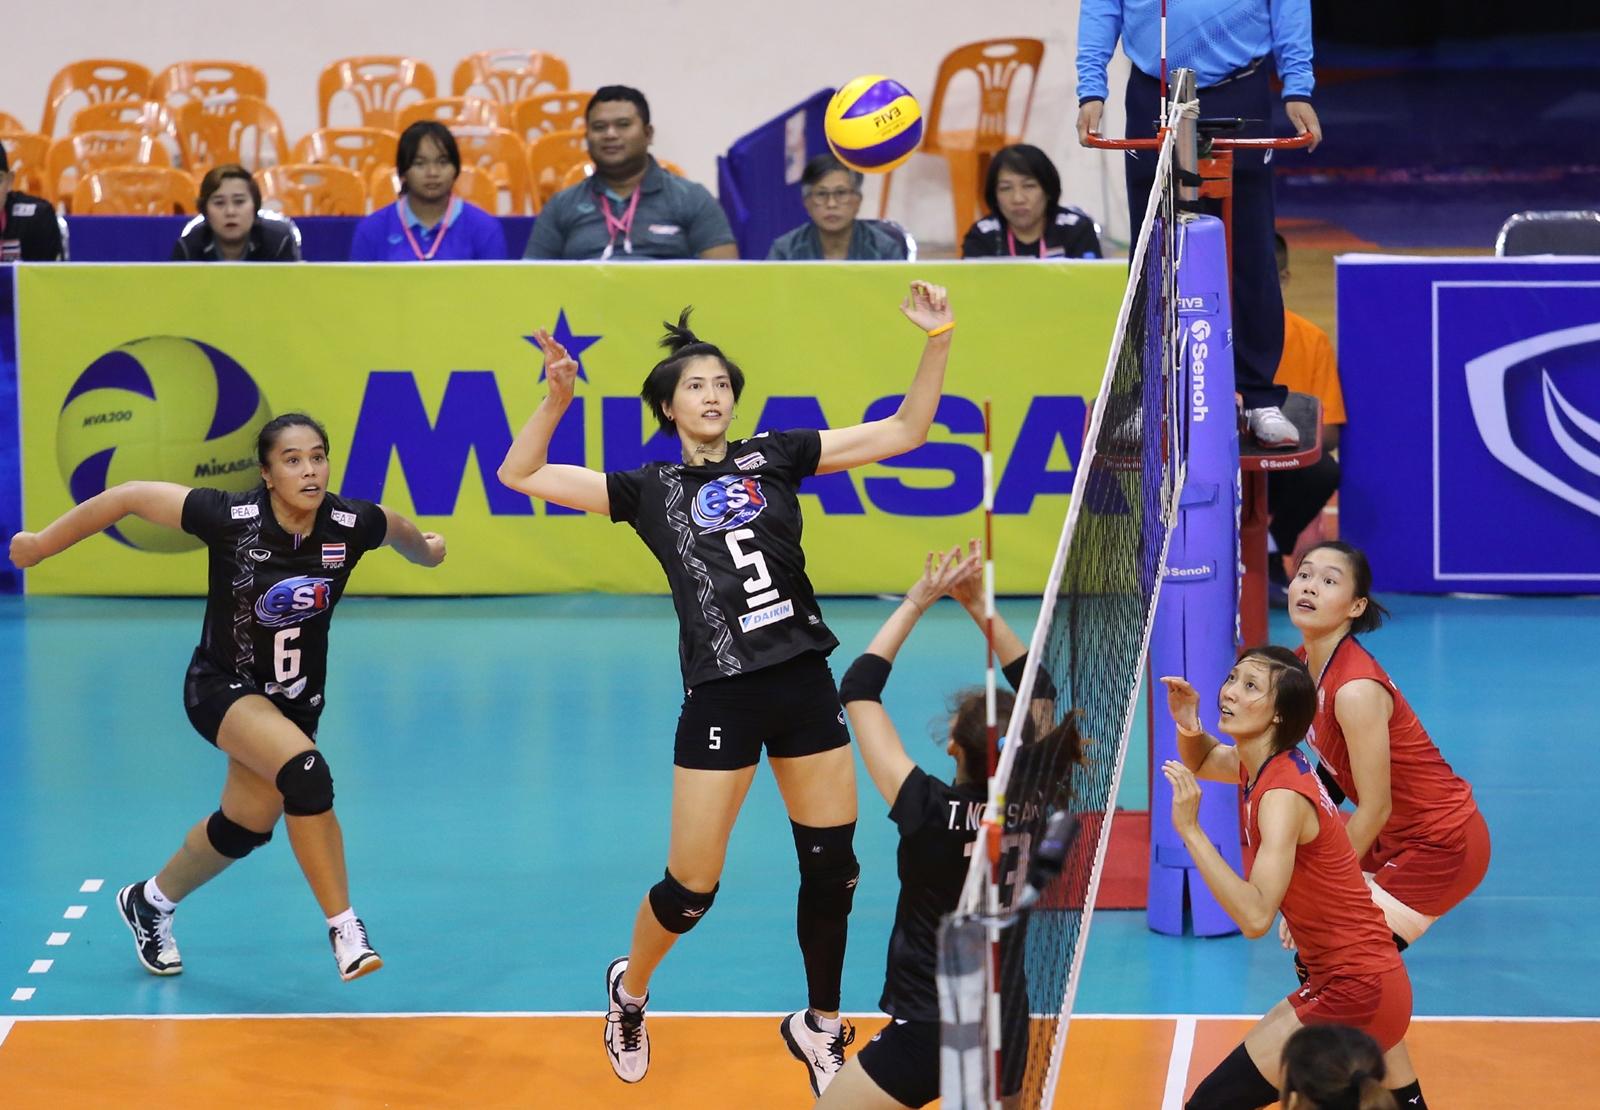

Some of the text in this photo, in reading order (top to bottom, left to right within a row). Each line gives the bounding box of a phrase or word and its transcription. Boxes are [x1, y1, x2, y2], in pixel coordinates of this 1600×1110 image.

[873, 106, 901, 128] FIVB
[1192, 342, 1209, 422] Senoh
[82, 410, 133, 428] MVA200
[1269, 458, 1300, 468] Senoh
[231, 507, 251, 517] PEA
[725, 528, 773, 594] 5
[1171, 565, 1211, 577] Senoh
[753, 604, 790, 624] DAIKIN
[273, 626, 302, 683] 6
[708, 726, 722, 750] 5
[948, 800, 960, 830] T.
